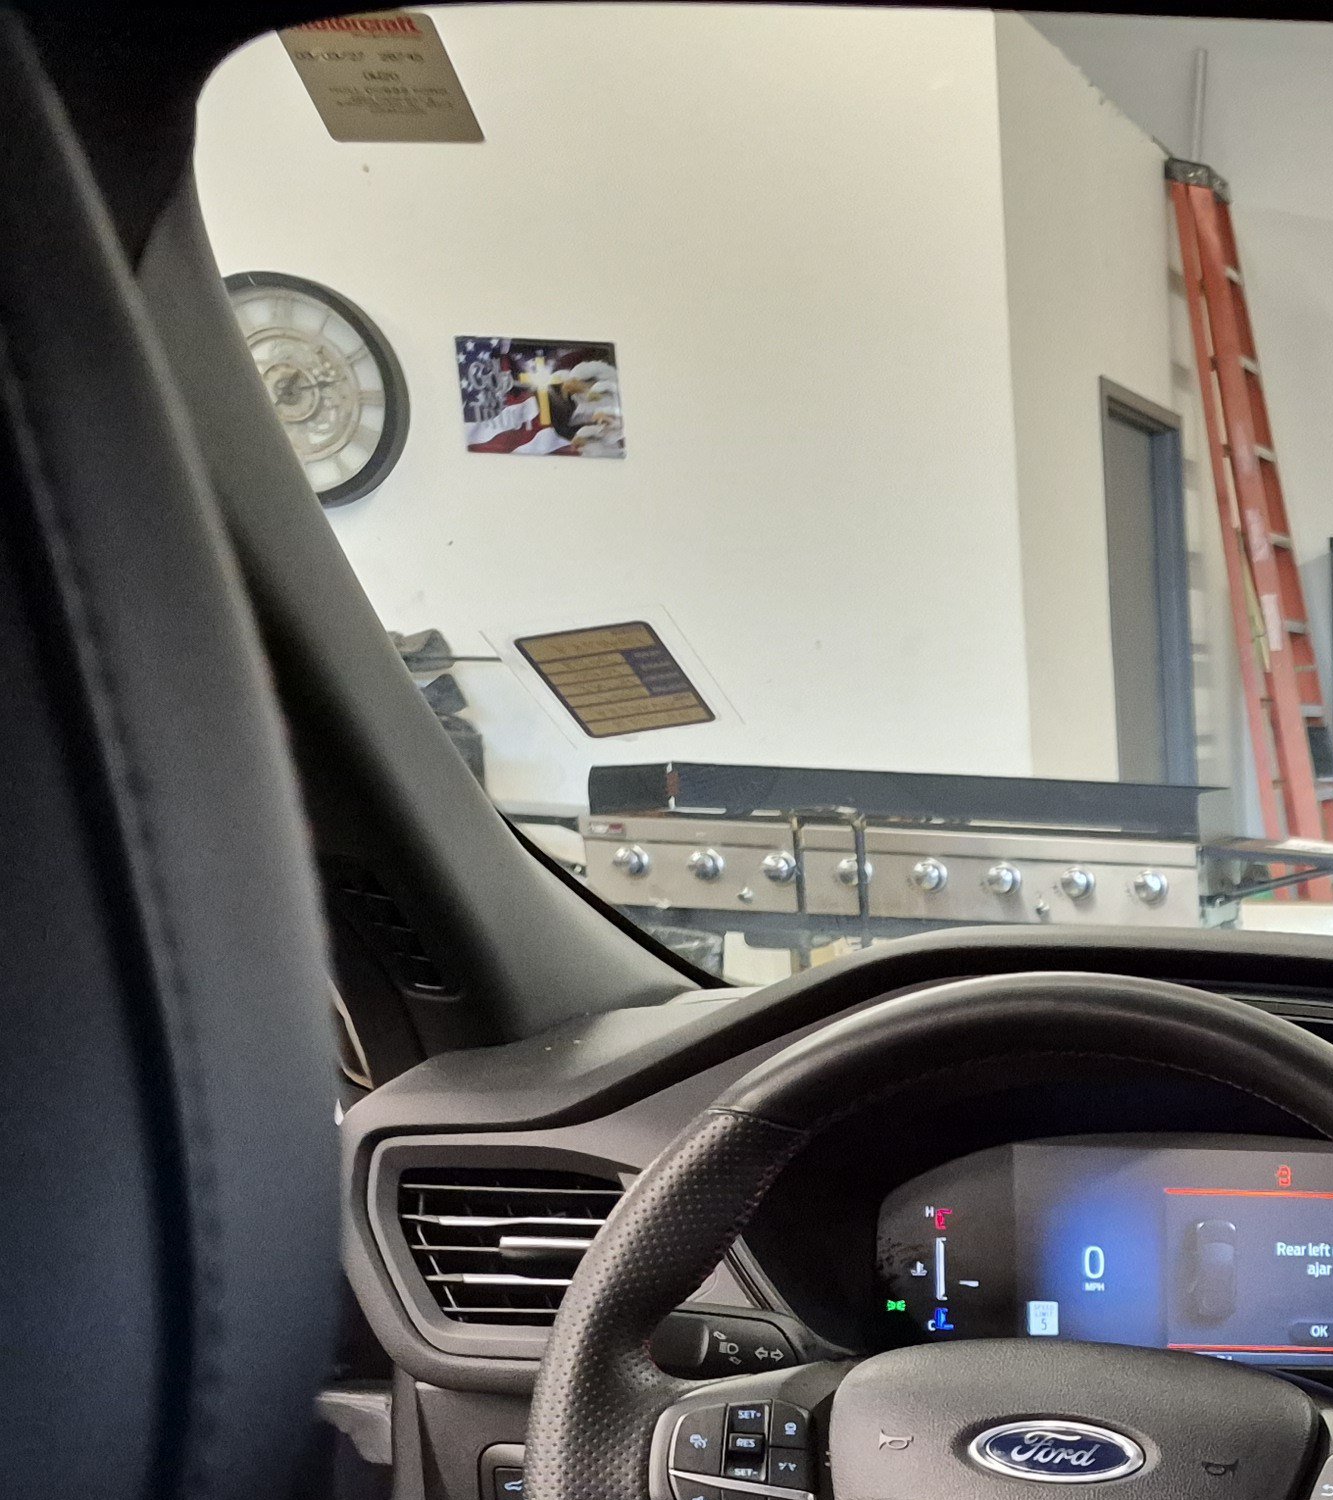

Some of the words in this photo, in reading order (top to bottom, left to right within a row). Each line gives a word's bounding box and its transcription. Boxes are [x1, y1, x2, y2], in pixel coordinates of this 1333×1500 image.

[1276, 1242, 1306, 1257] Rear
[1308, 1242, 1331, 1258] left
[1083, 1245, 1106, 1279] 0
[1307, 1261, 1332, 1278] ajar
[1084, 1281, 1106, 1292] MPH
[1309, 1325, 1329, 1338] OK
[736, 1437, 756, 1448] RES
[1010, 1429, 1101, 1468] Ford
